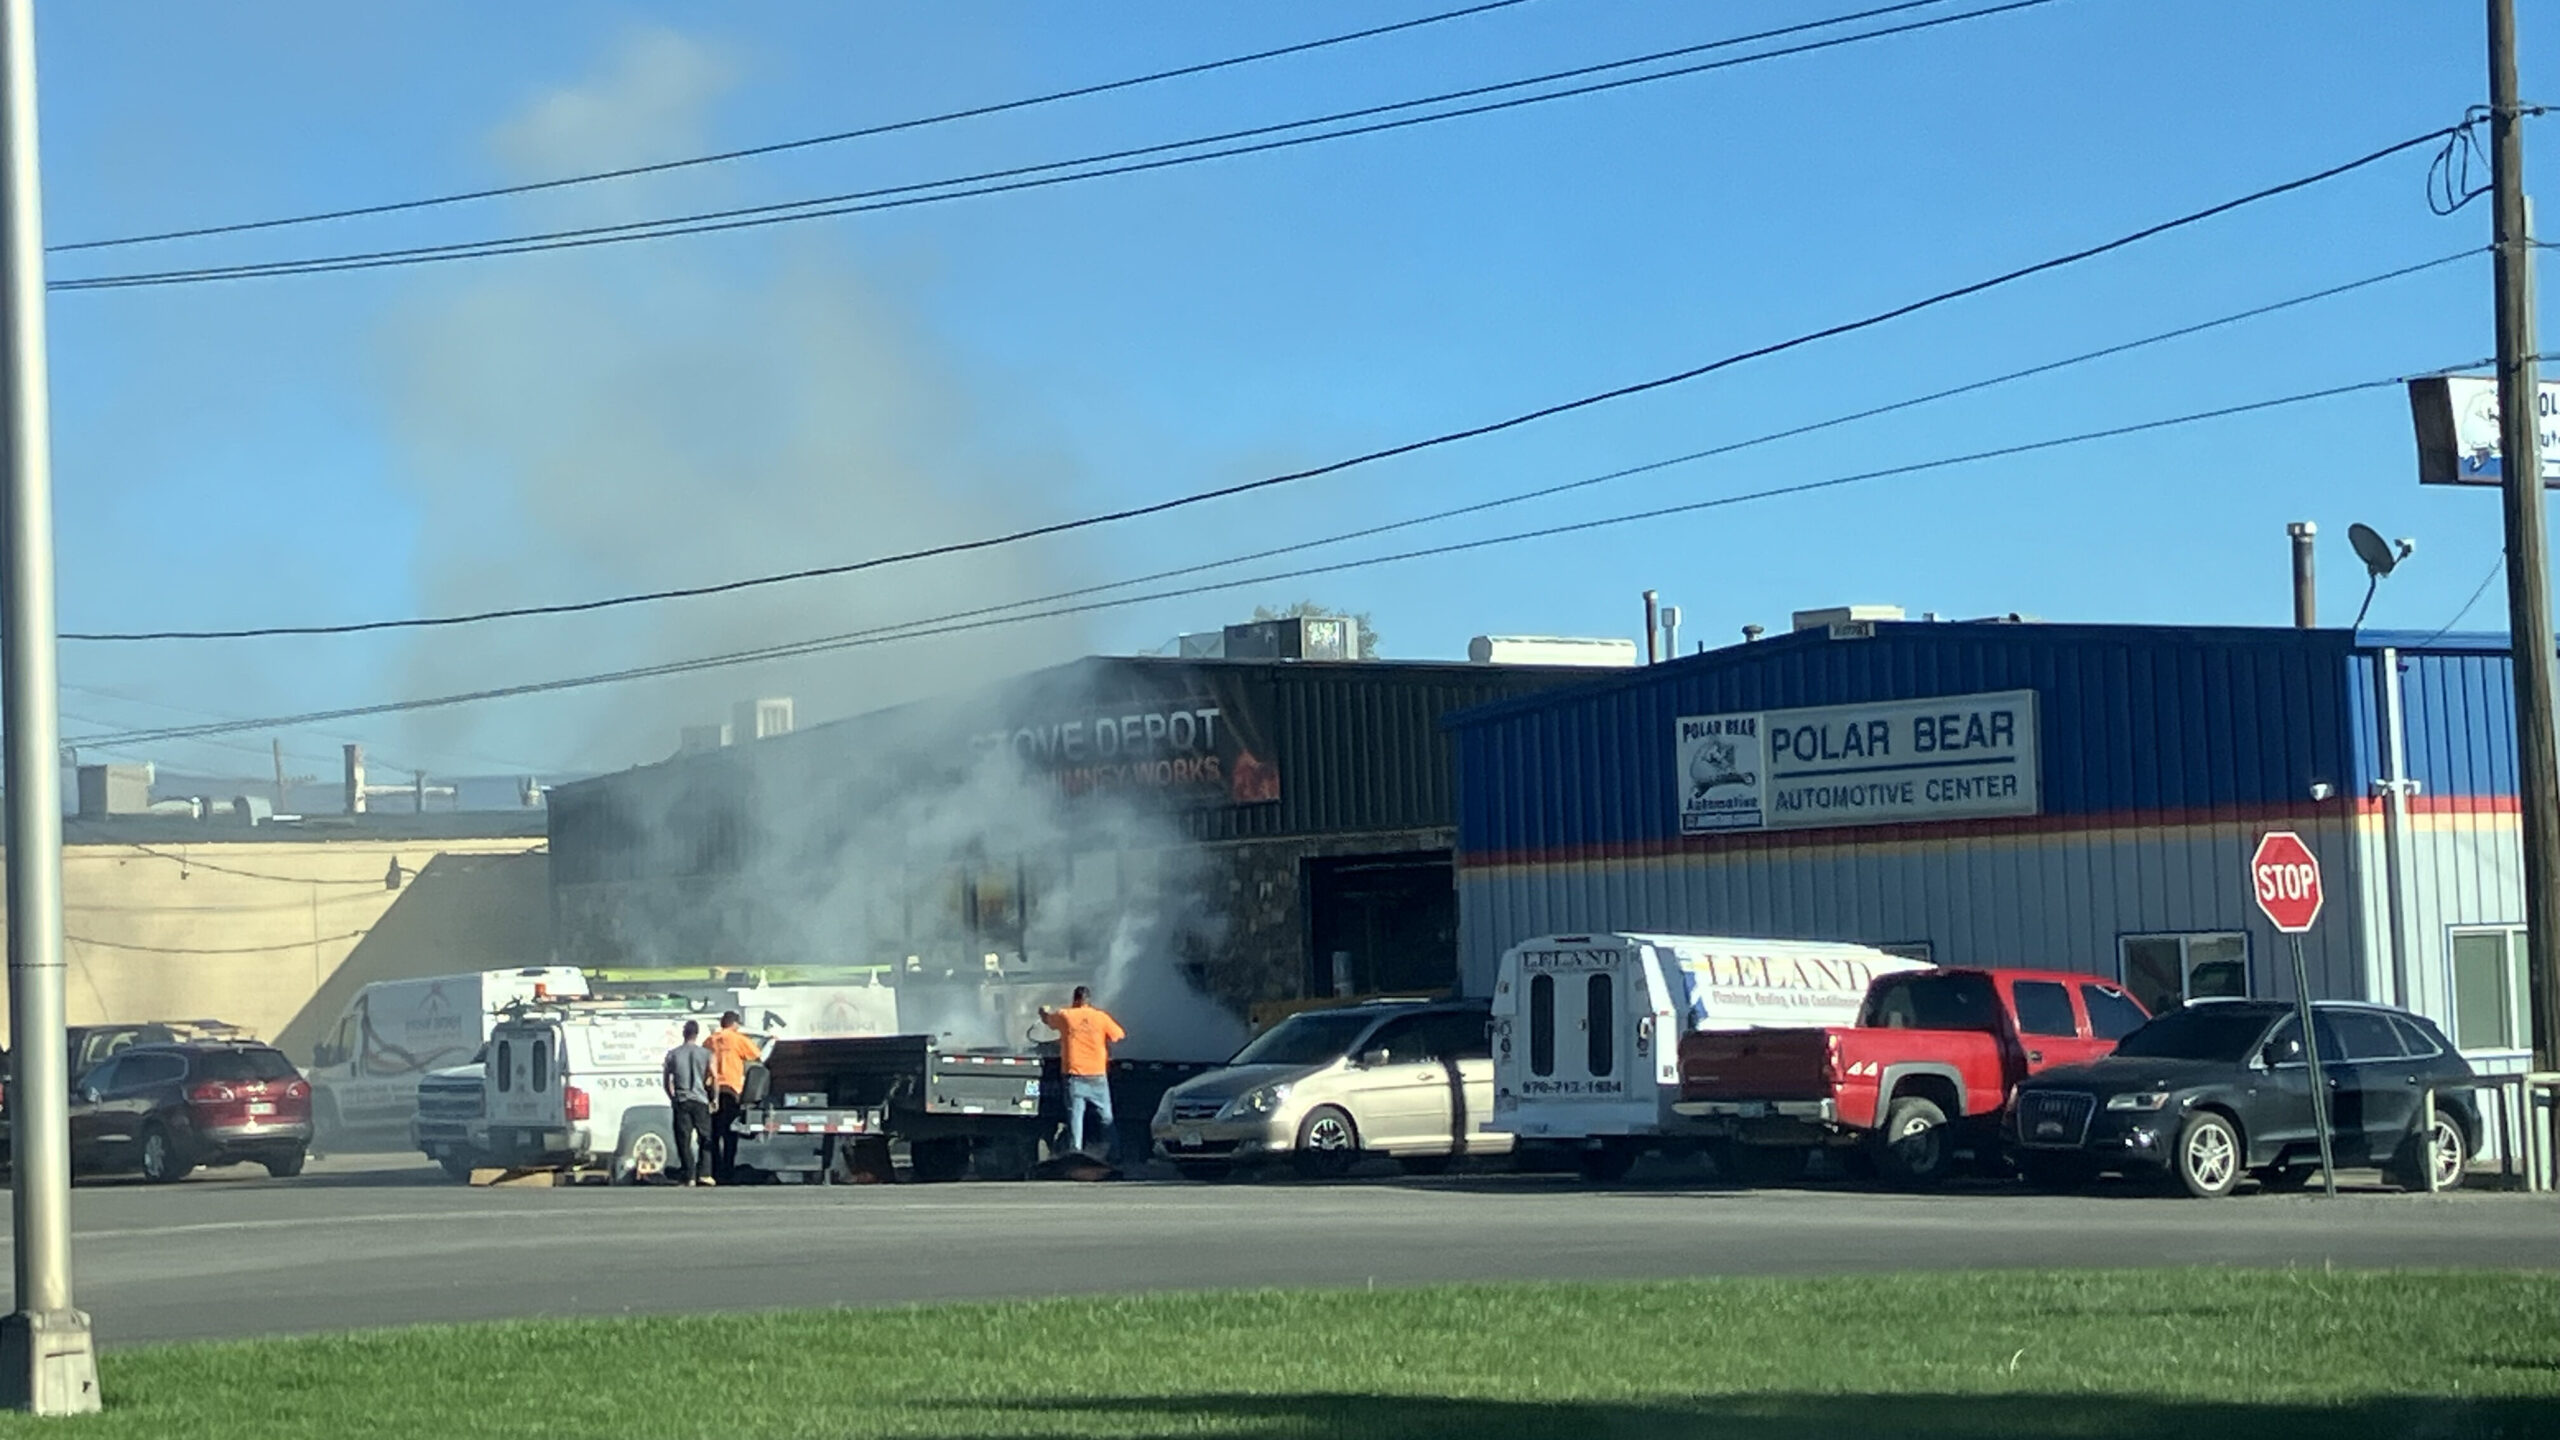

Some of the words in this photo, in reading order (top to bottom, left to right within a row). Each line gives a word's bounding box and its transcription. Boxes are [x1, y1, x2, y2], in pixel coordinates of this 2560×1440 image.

[1094, 707, 1221, 759] DEPOT
[1682, 719, 1722, 743] POLAR
[1725, 717, 1757, 739] BEAR
[1771, 719, 1891, 764] POLAR
[1913, 709, 2016, 754] BEAR
[1132, 755, 1222, 788] WORKS
[1774, 780, 1915, 812] AUTOMOTIVE
[1925, 774, 2018, 803] CENTER
[2258, 863, 2314, 902] STOP
[1523, 949, 1621, 968] LELAND
[1703, 953, 1873, 992] LELAND
